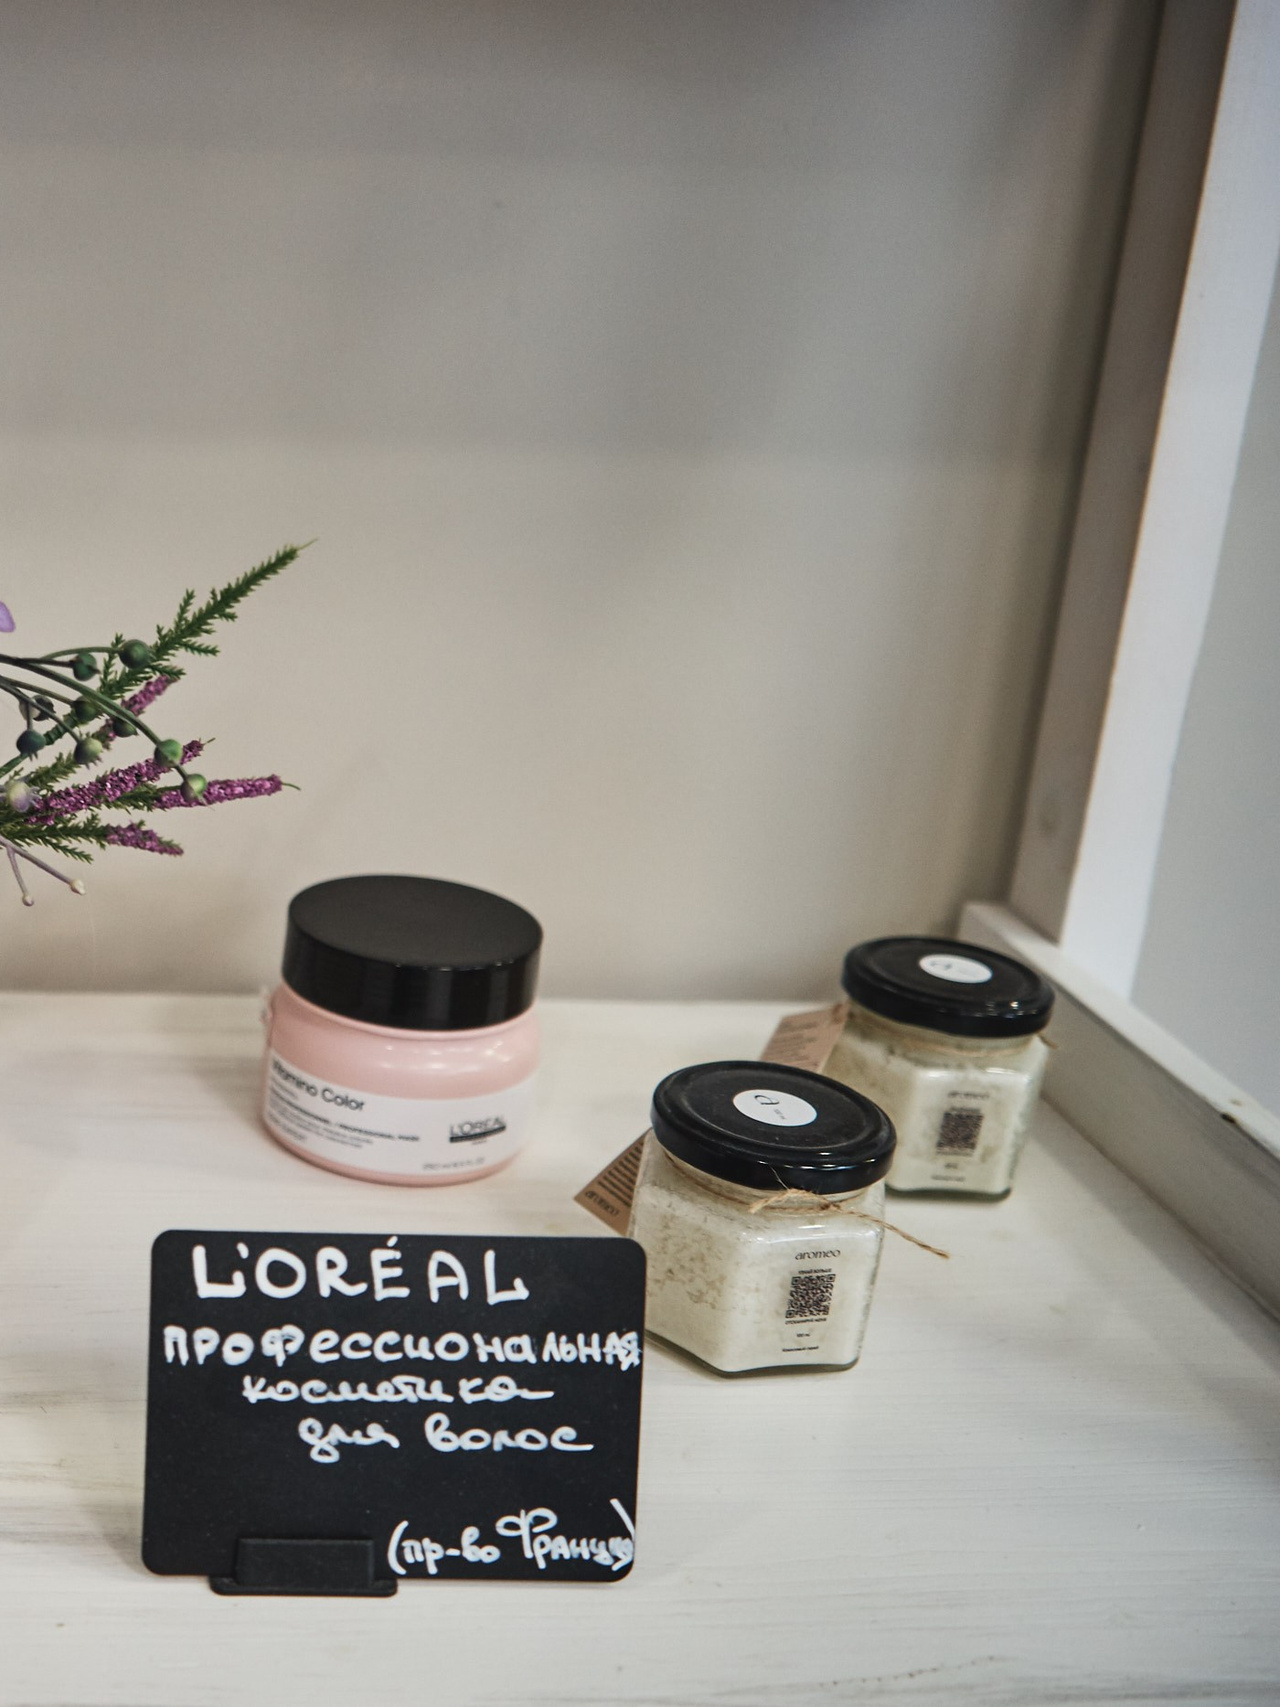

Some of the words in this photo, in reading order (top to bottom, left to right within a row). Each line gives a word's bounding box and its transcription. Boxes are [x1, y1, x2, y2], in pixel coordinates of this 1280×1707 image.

[321, 1087, 365, 1112] Color
[192, 1236, 530, 1305] L'ORÉAL
[298, 1417, 400, 1463] для
[424, 1412, 595, 1452] волос
